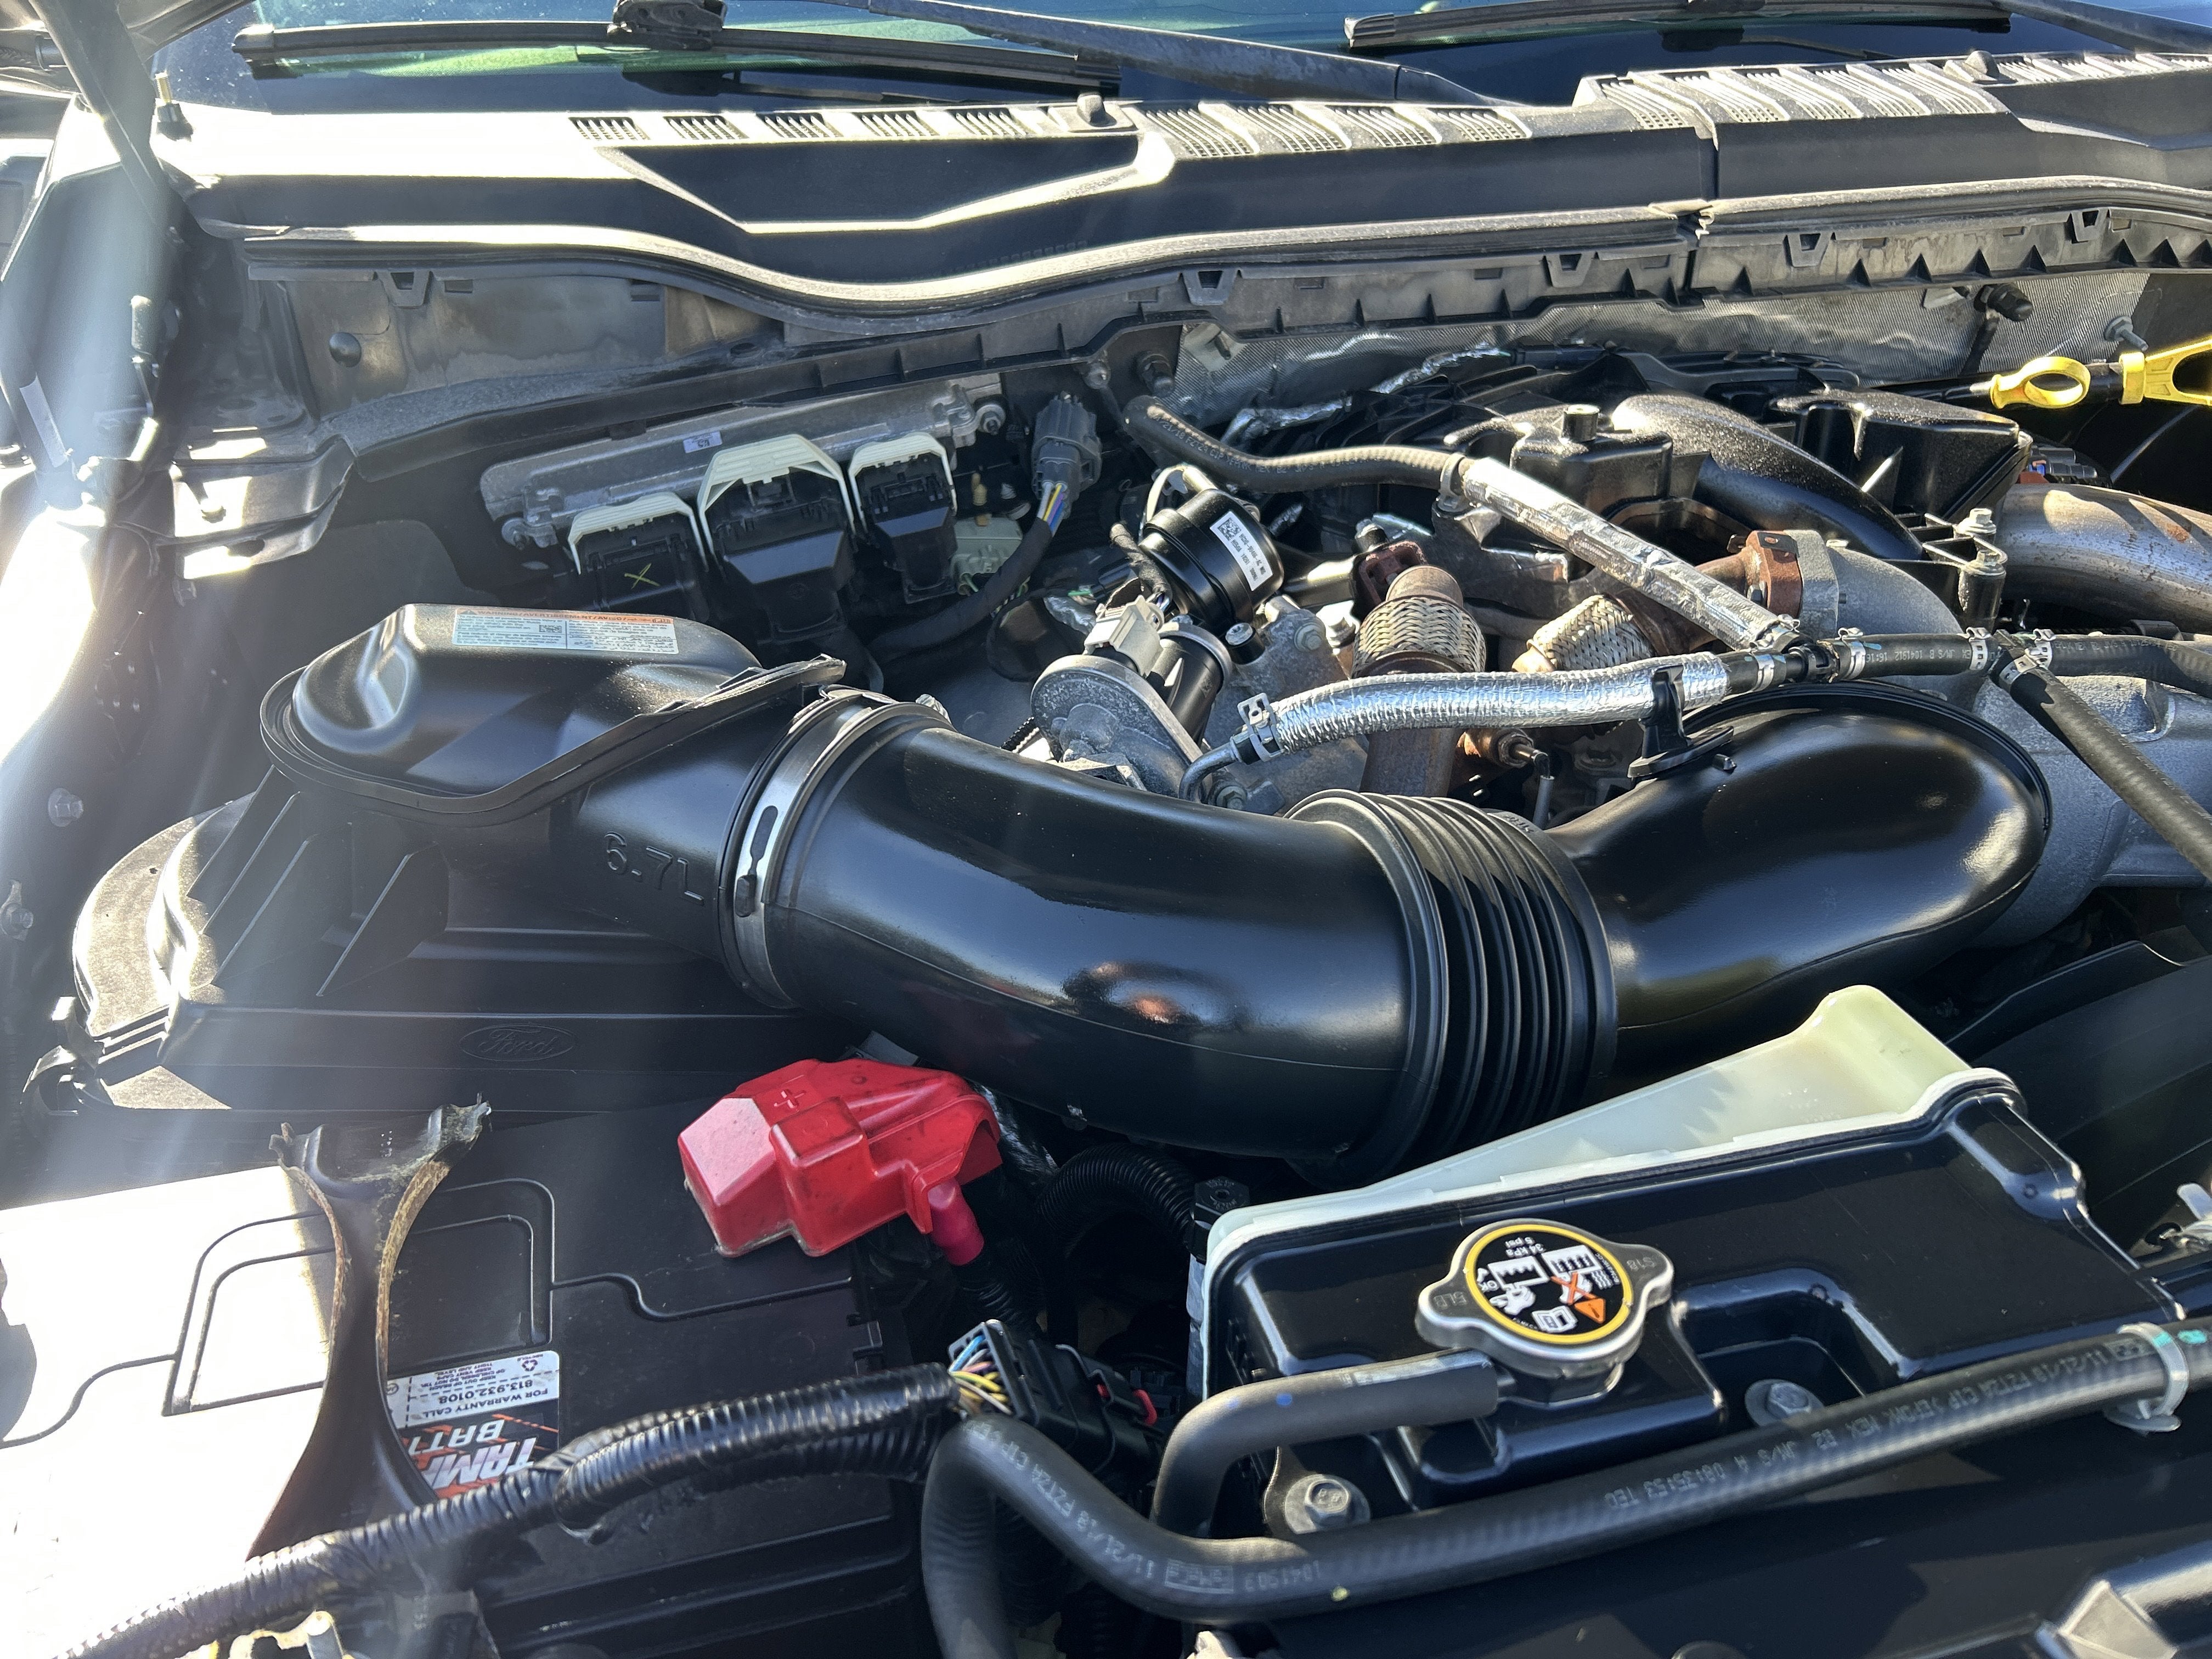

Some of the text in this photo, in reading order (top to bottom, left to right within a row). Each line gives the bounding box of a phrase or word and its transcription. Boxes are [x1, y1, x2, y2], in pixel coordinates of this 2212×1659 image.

[603, 832, 706, 906] 6.7L
[479, 1027, 563, 1057] Ford
[1530, 1244, 1544, 1254] 34
[1479, 1280, 1499, 1293] OK
[422, 1388, 548, 1418] FOR WARRANTY CALL
[439, 1379, 533, 1404] 813.932.0108
